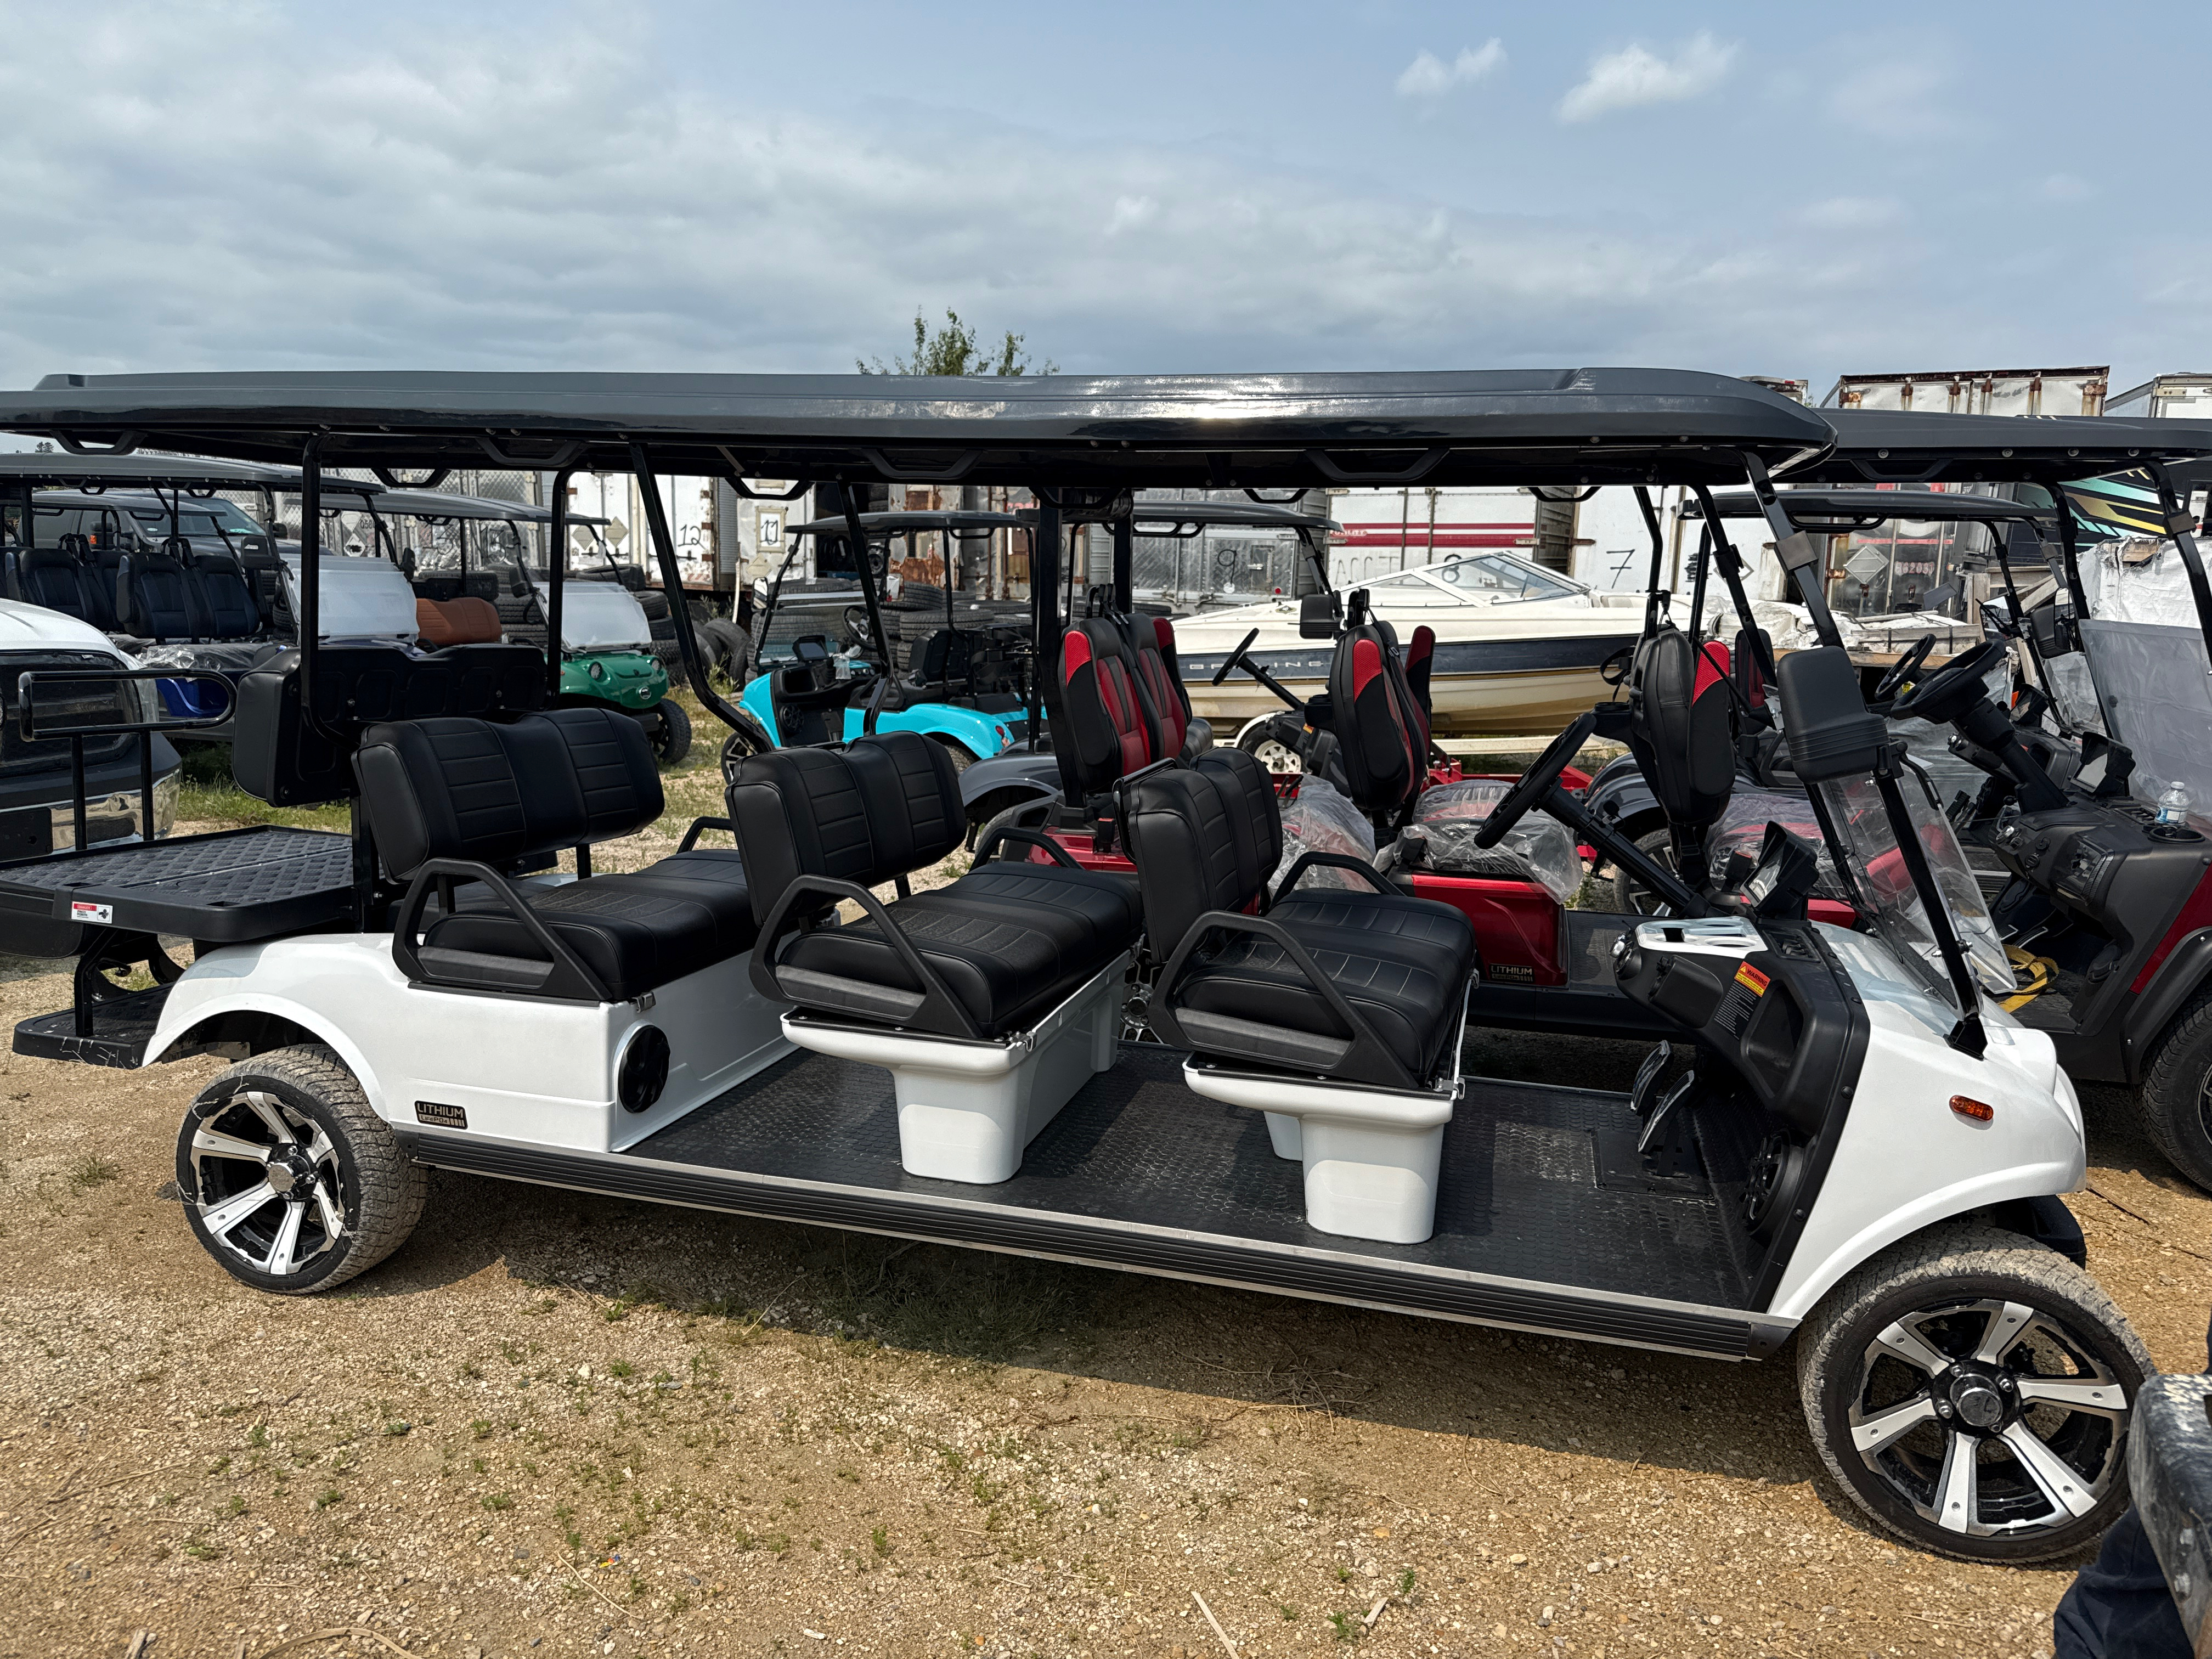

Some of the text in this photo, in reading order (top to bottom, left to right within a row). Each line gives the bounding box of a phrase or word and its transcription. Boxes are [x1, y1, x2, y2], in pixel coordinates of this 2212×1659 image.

[678, 524, 706, 550] 12
[1217, 549, 1237, 585] 9
[1441, 554, 1463, 583] 8
[1606, 549, 1635, 589] 7
[1491, 965, 1532, 975] LITHIUM
[1747, 968, 1768, 987] WARNING
[417, 1103, 464, 1118] LITHIUM
